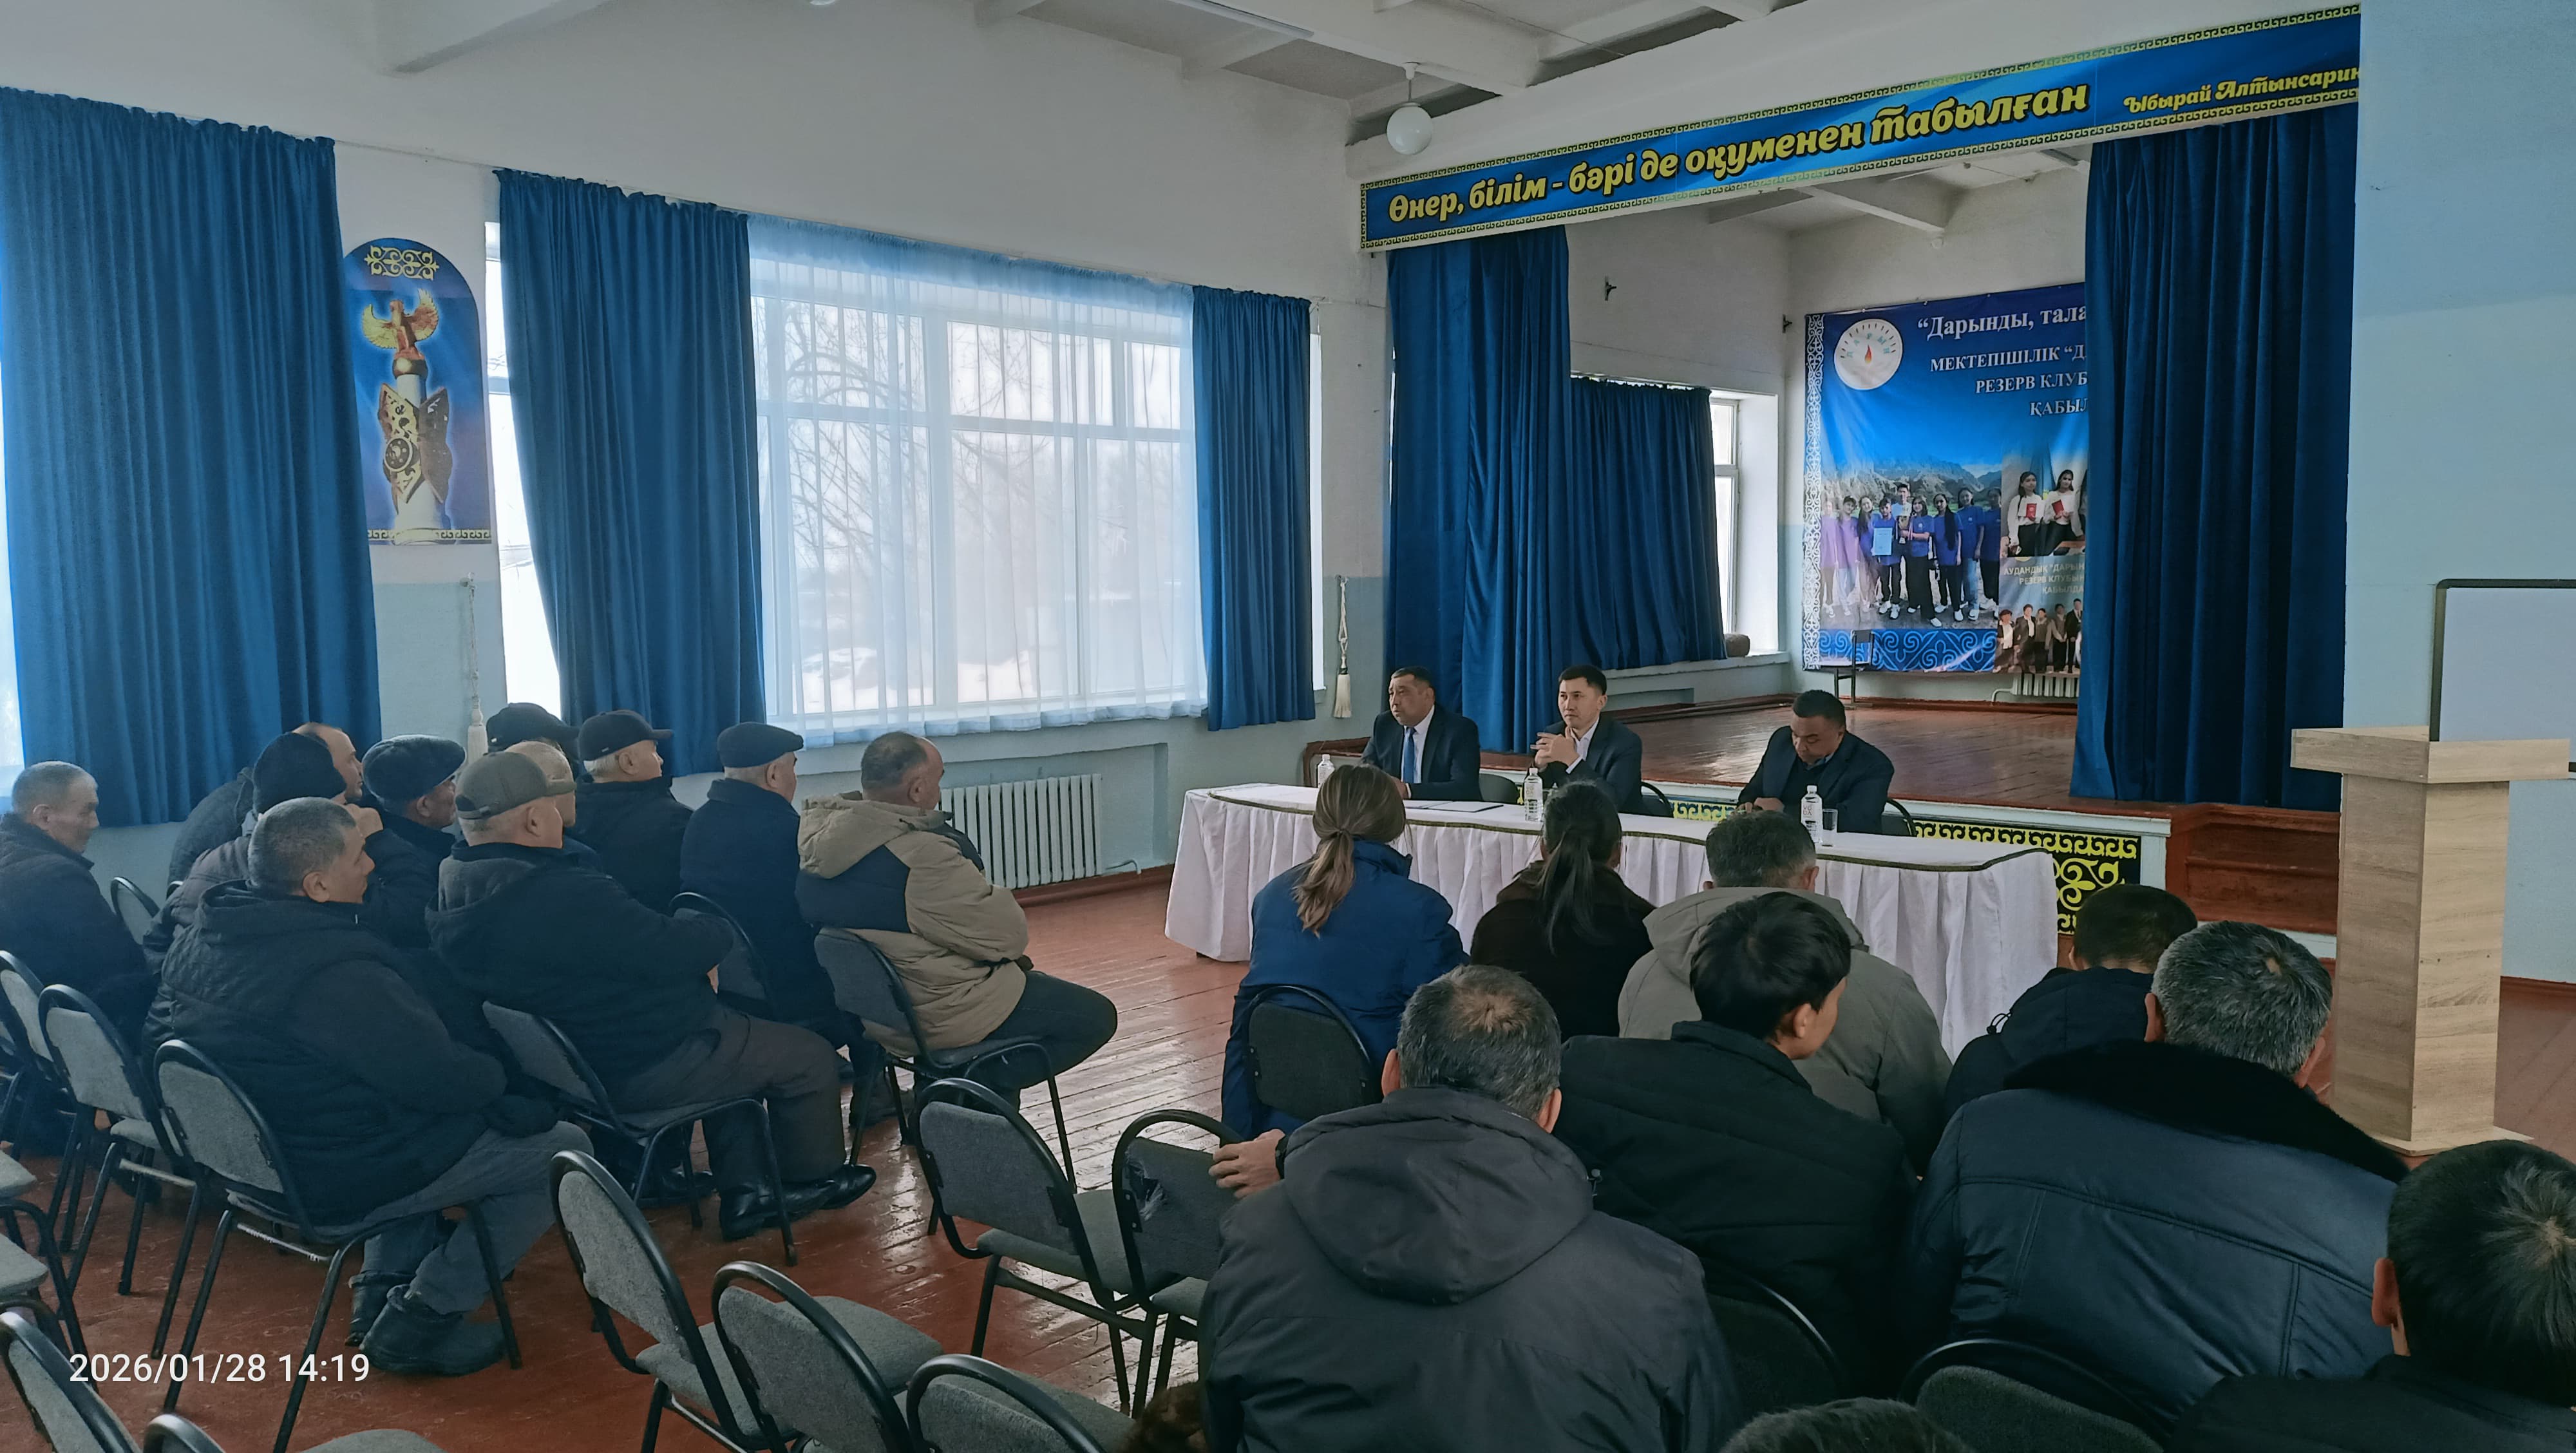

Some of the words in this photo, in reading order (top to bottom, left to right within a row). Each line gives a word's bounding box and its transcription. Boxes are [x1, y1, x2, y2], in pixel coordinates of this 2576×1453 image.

[2123, 85, 2211, 114] Ыбырай
[1388, 194, 1464, 223] Өнер,
[1468, 172, 1546, 210] білім
[1568, 153, 1635, 195] бәрі
[1640, 149, 1679, 182] де
[1684, 121, 1865, 180] оқуменен
[1869, 84, 2089, 143] табылған
[2040, 305, 2087, 325] тала
[1975, 375, 2036, 394] РЕЗЕРВ
[2040, 371, 2088, 388] КЛУБ
